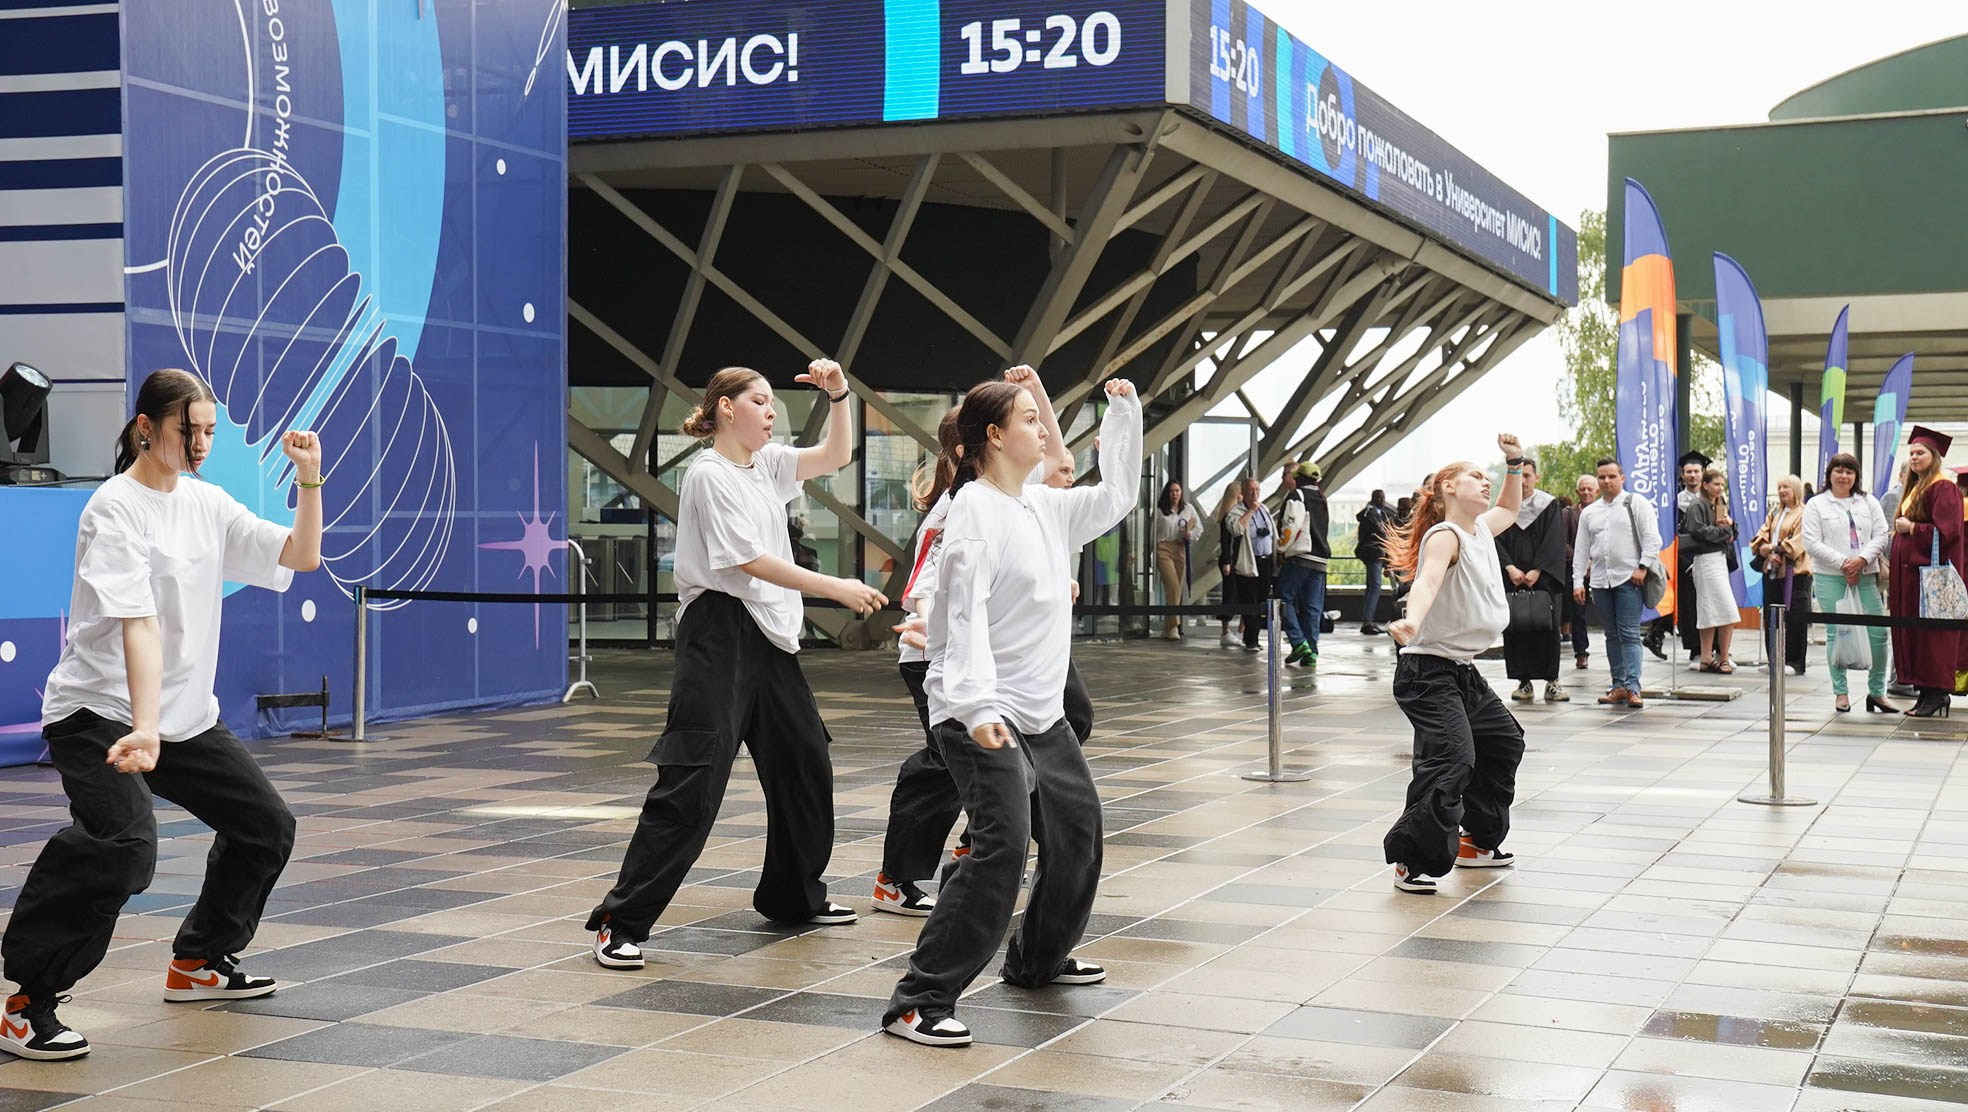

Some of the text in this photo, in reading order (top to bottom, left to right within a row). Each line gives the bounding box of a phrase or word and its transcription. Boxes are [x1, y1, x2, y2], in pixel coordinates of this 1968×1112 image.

[567, 34, 798, 95] МИСИС!
[960, 11, 1122, 75] 15:20
[1210, 25, 1259, 98] 15:20
[1306, 82, 1541, 260] Добро пожаловать в Университет МИСИС!
